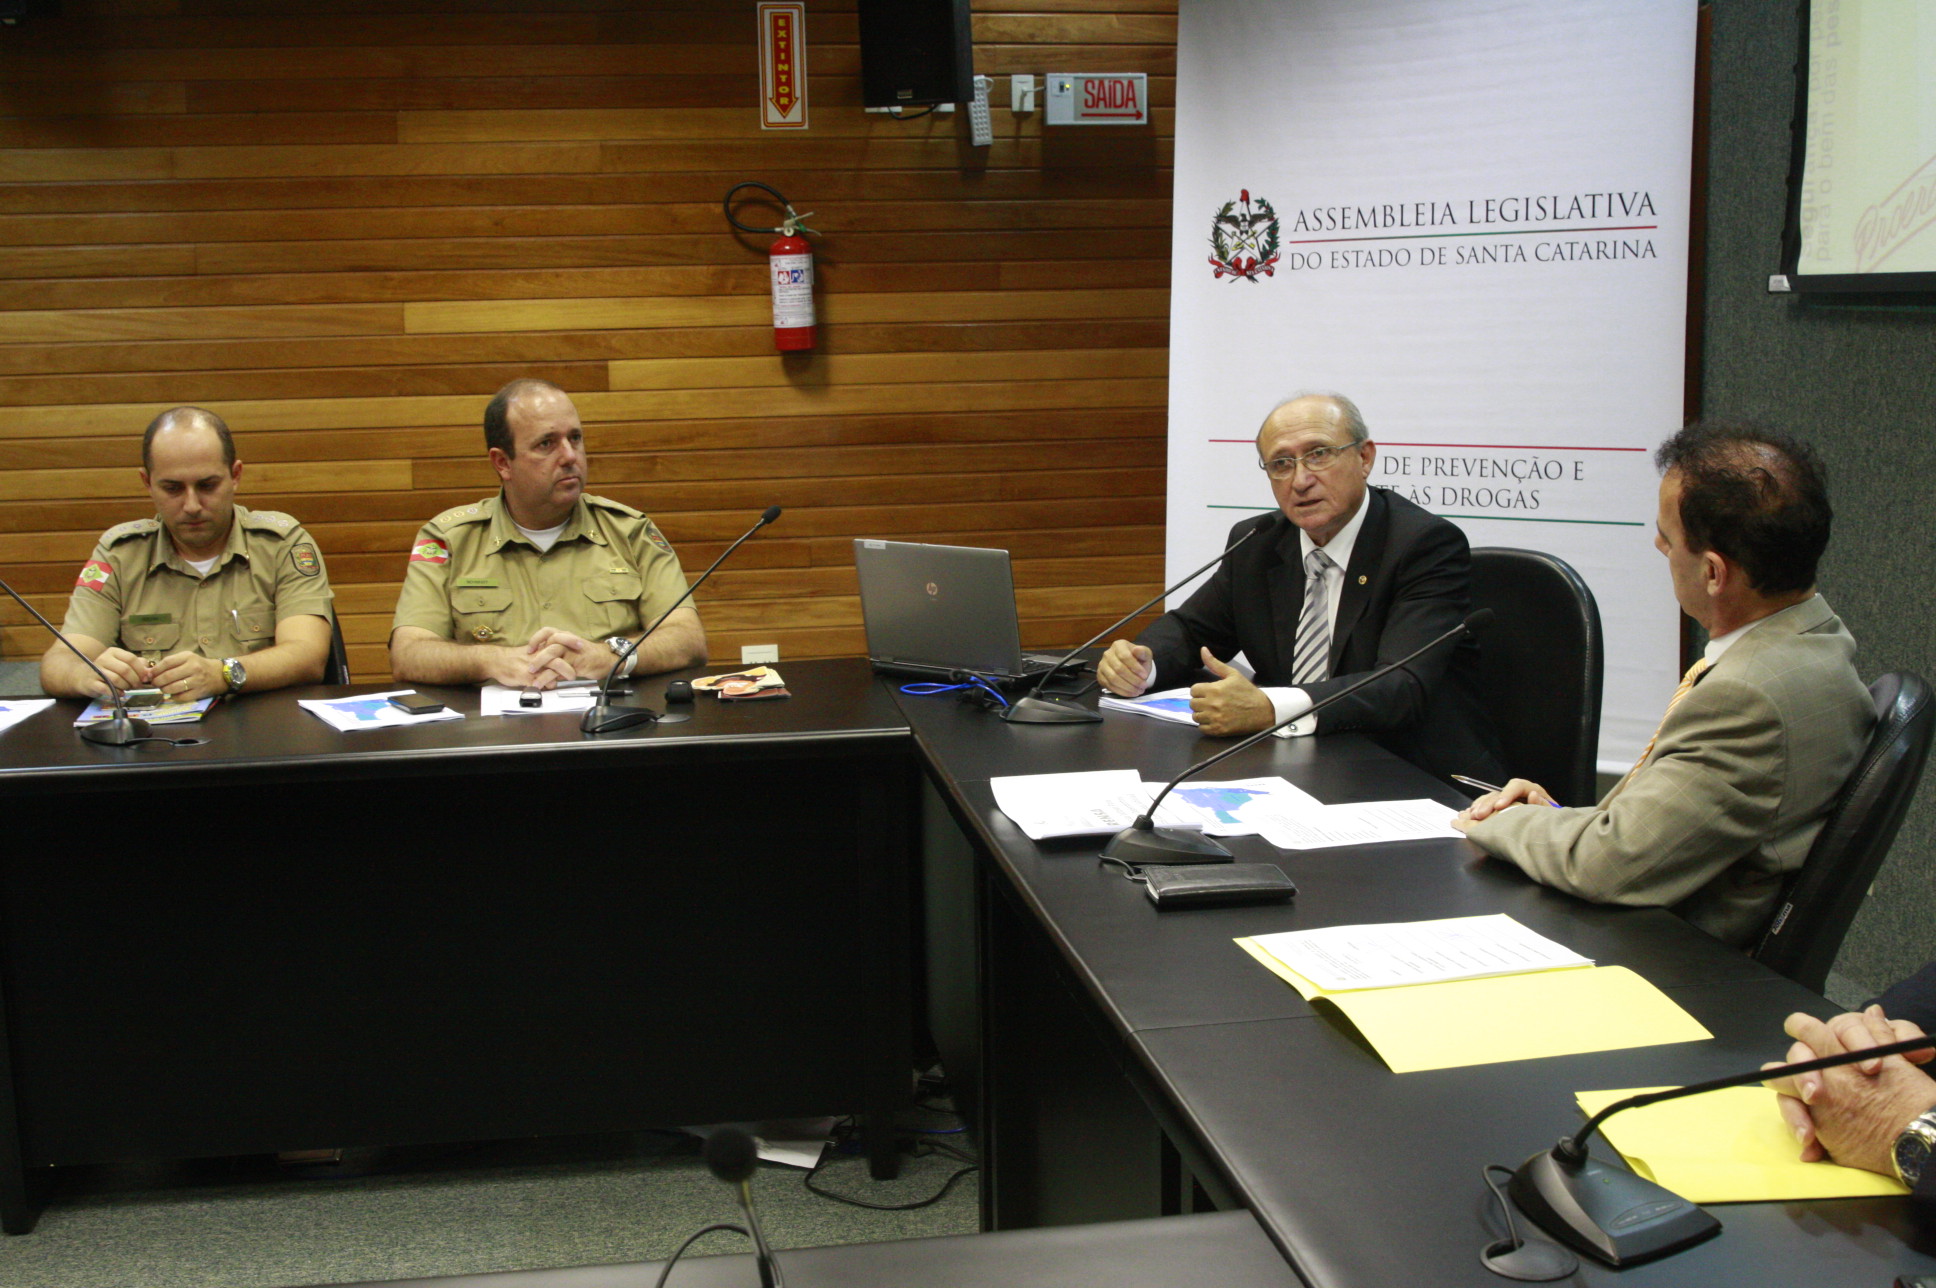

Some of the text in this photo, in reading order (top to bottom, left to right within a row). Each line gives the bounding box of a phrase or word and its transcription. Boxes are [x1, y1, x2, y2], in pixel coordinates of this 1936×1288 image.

[777, 18, 790, 105] EXTINTOR
[1820, 56, 1838, 104] das
[1817, 111, 1835, 168] bem
[1819, 178, 1832, 194] o
[1293, 191, 1658, 232] ASSEMBLEIA LEGISLATIVA
[1816, 203, 1832, 261] para
[1291, 251, 1322, 271] DO
[1331, 248, 1411, 269] ESTADO
[1420, 246, 1447, 266] DE
[1455, 244, 1528, 265] SANTA
[1534, 239, 1658, 262] CATARINA
[1383, 455, 1584, 484] DE PREVENÇÃO E
[1409, 485, 1541, 510] ÀS DROGAS
